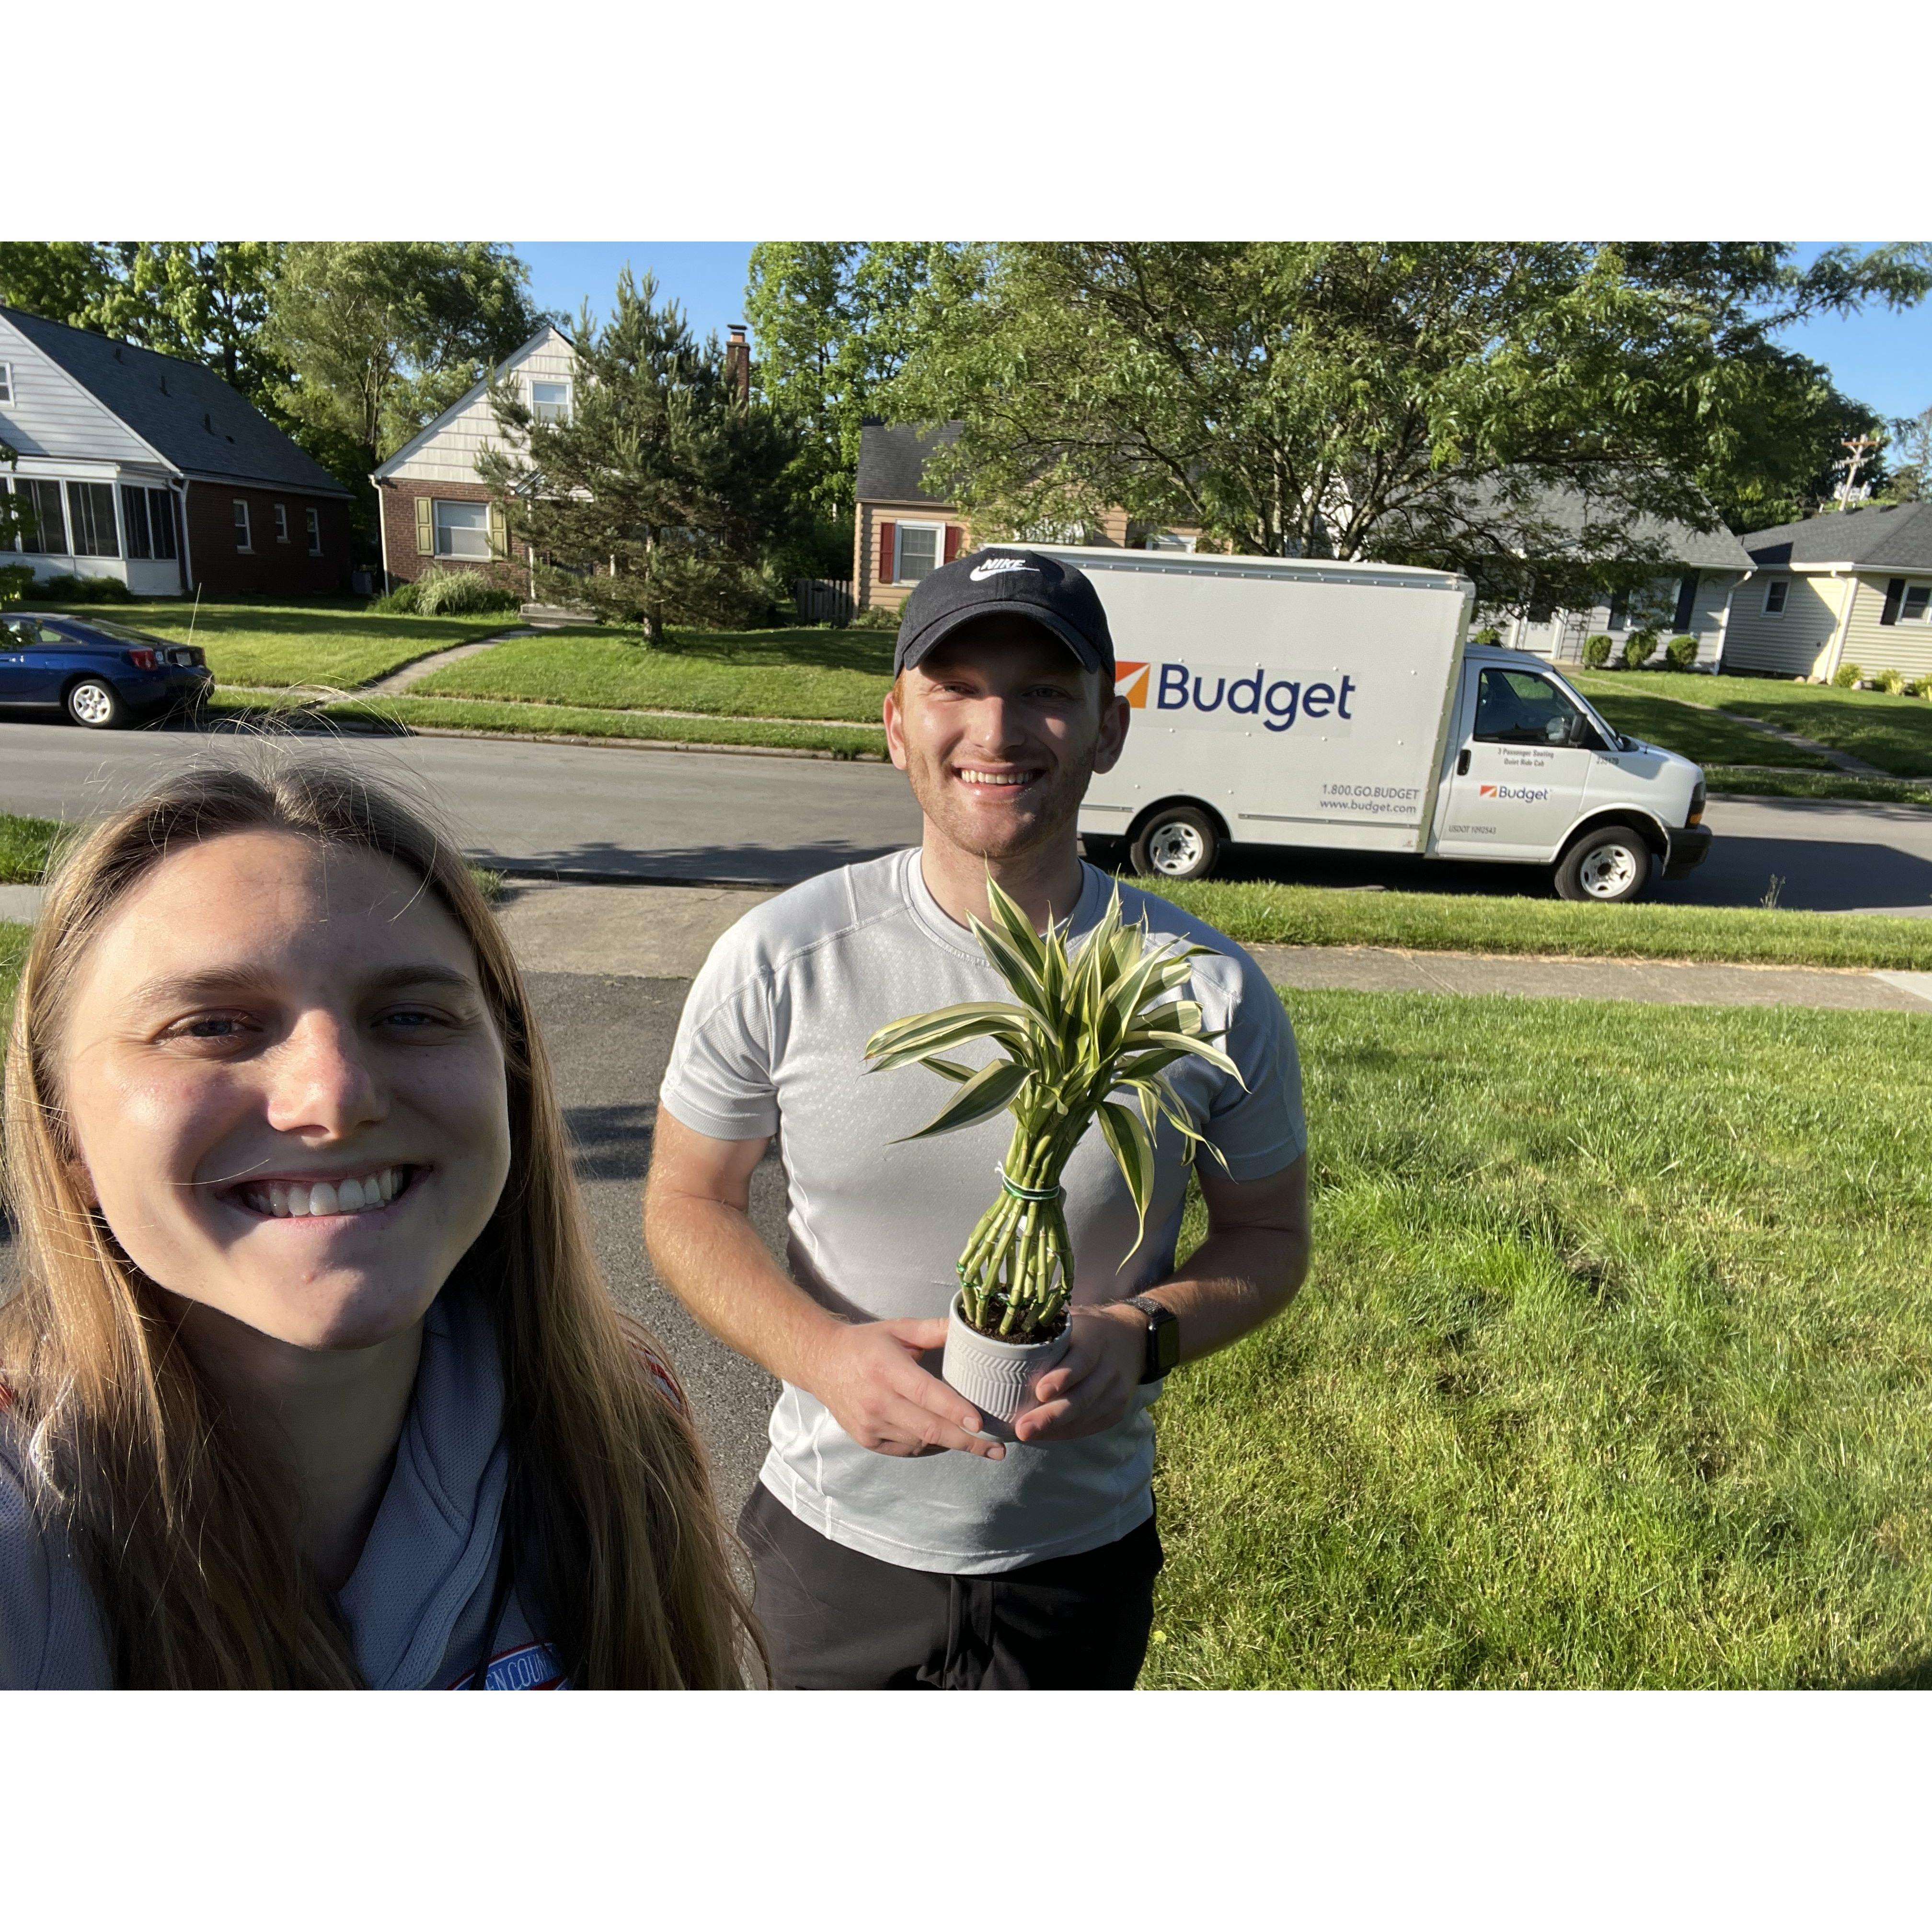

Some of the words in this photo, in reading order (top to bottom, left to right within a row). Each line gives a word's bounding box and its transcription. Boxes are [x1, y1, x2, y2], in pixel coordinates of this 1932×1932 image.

[980, 559, 1026, 570] NIKE
[1157, 663, 1356, 732] Budget
[1322, 784, 1419, 799] 1.800.GO.BUDGET
[1498, 785, 1549, 804] Budget
[1320, 799, 1416, 814] www.budget.com
[508, 1653, 549, 1690] COUN
